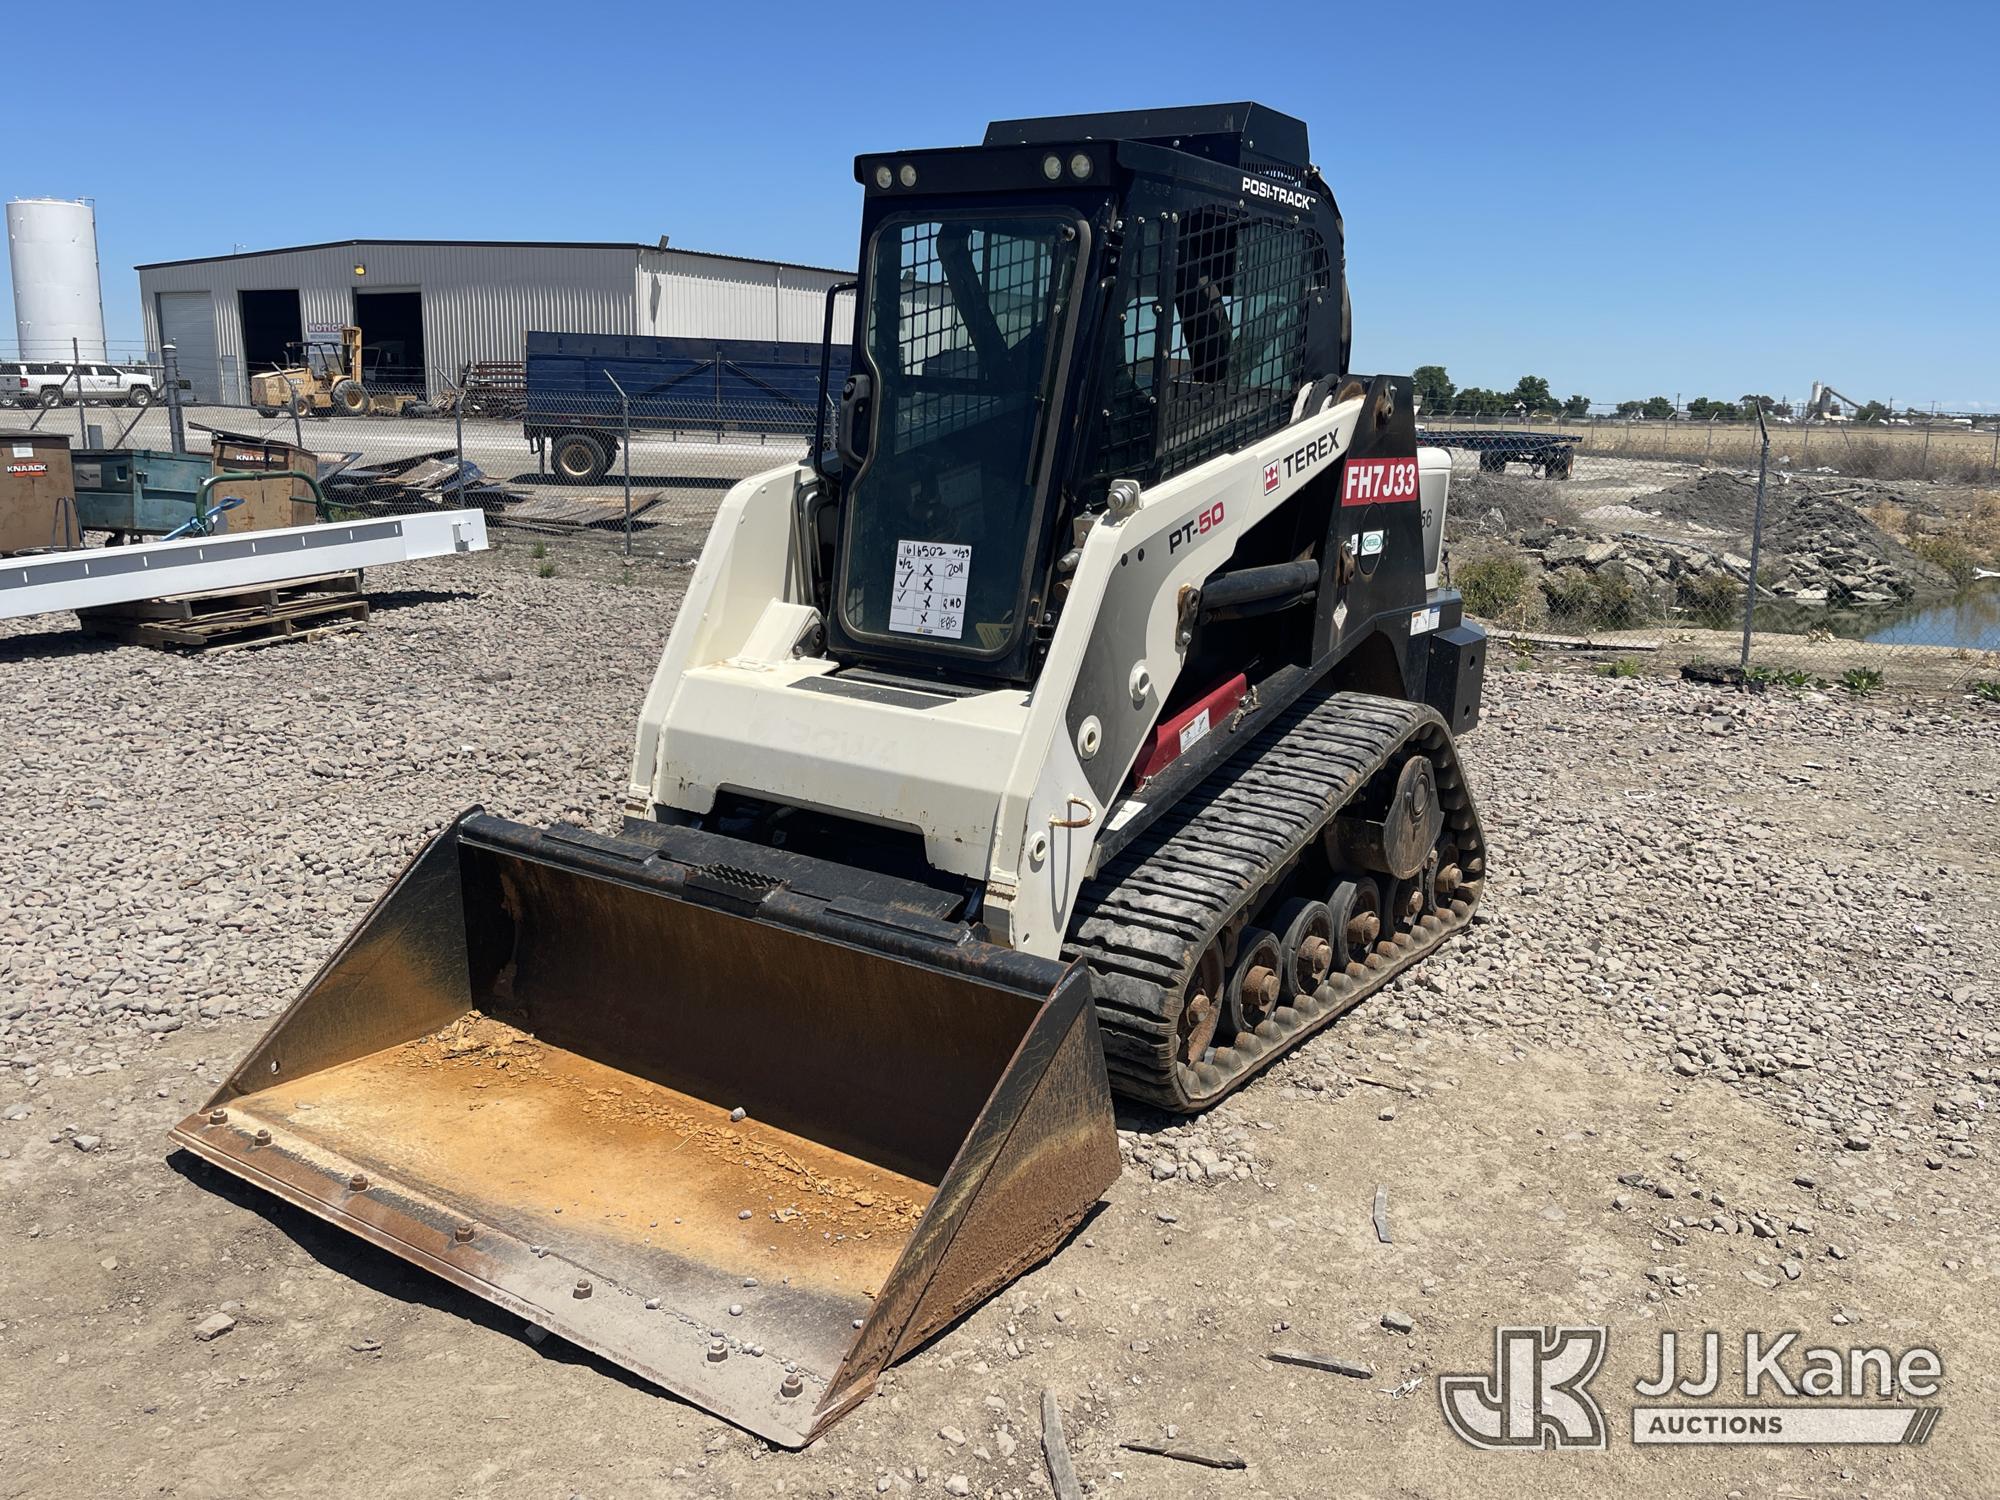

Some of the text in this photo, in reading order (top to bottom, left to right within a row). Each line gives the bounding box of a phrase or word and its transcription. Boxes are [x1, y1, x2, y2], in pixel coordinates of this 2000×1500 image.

[6, 464, 48, 473] KNAACK
[1283, 427, 1340, 479] TEREX
[1345, 463, 1416, 500] FH7J33
[1168, 501, 1225, 555] PT-50
